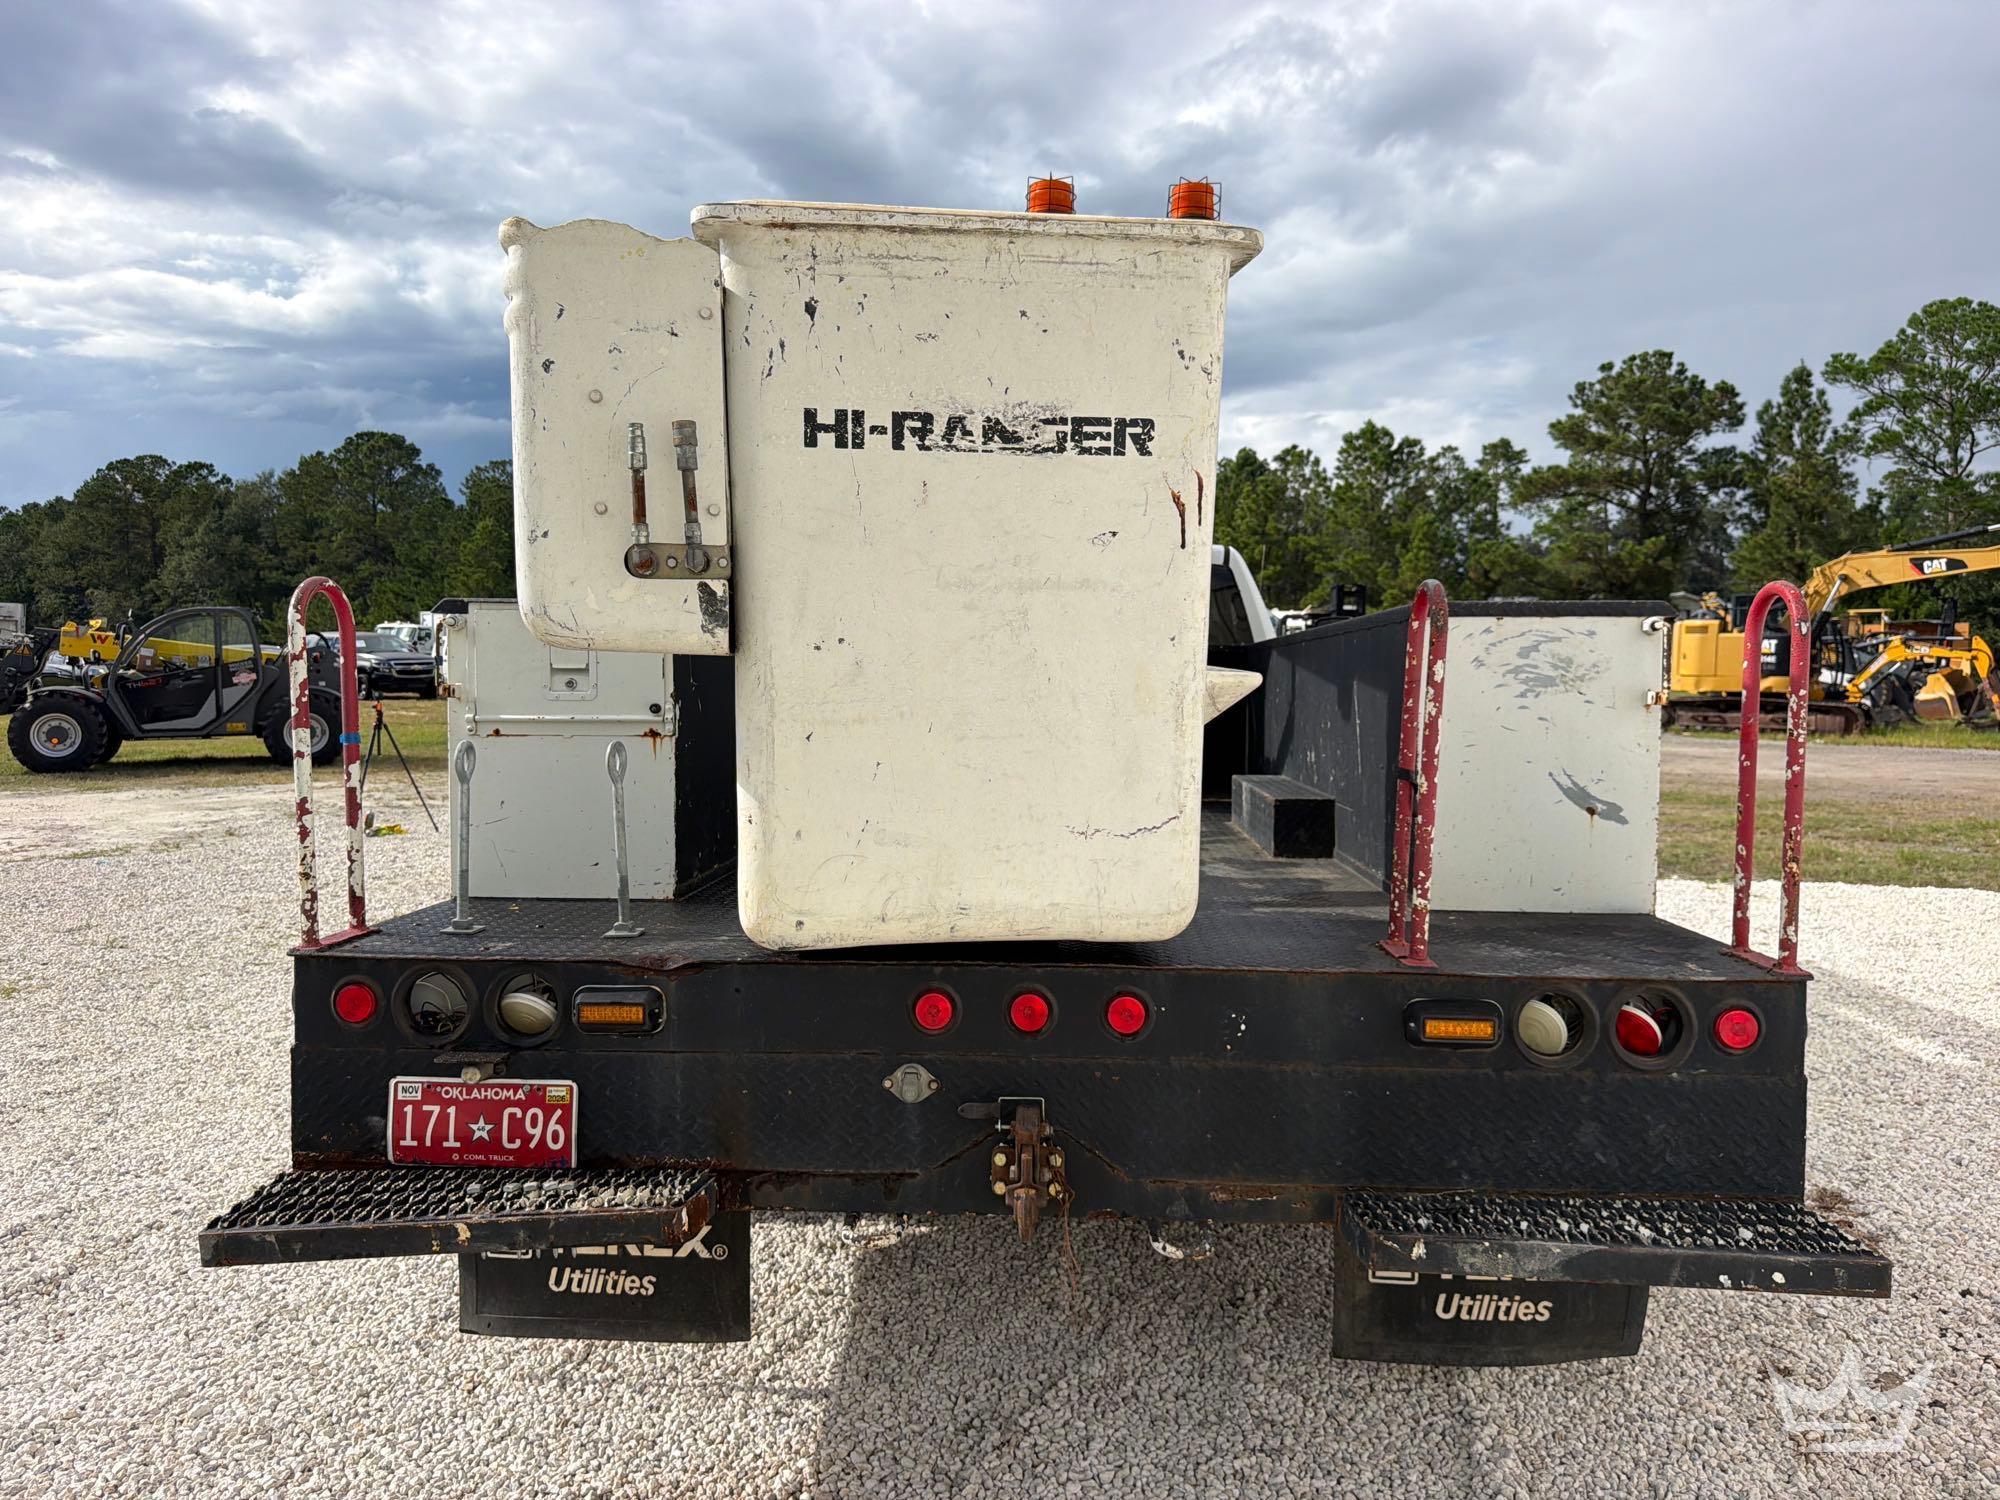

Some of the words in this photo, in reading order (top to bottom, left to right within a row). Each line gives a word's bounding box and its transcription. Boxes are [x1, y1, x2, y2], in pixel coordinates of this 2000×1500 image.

[804, 407, 1155, 457] HI-RANGER
[1923, 558, 1948, 574] CAT
[1761, 639, 1778, 654] AT
[401, 1085, 420, 1095] NOV
[441, 1086, 526, 1101] OKLAHOMA
[547, 1094, 565, 1103] 2026
[399, 1104, 461, 1148] 171
[502, 1107, 566, 1150] C96
[463, 1153, 487, 1161] COML
[488, 1153, 515, 1162] TRUCK
[548, 1267, 656, 1296] Utilities
[1435, 1293, 1553, 1322] Utilities
